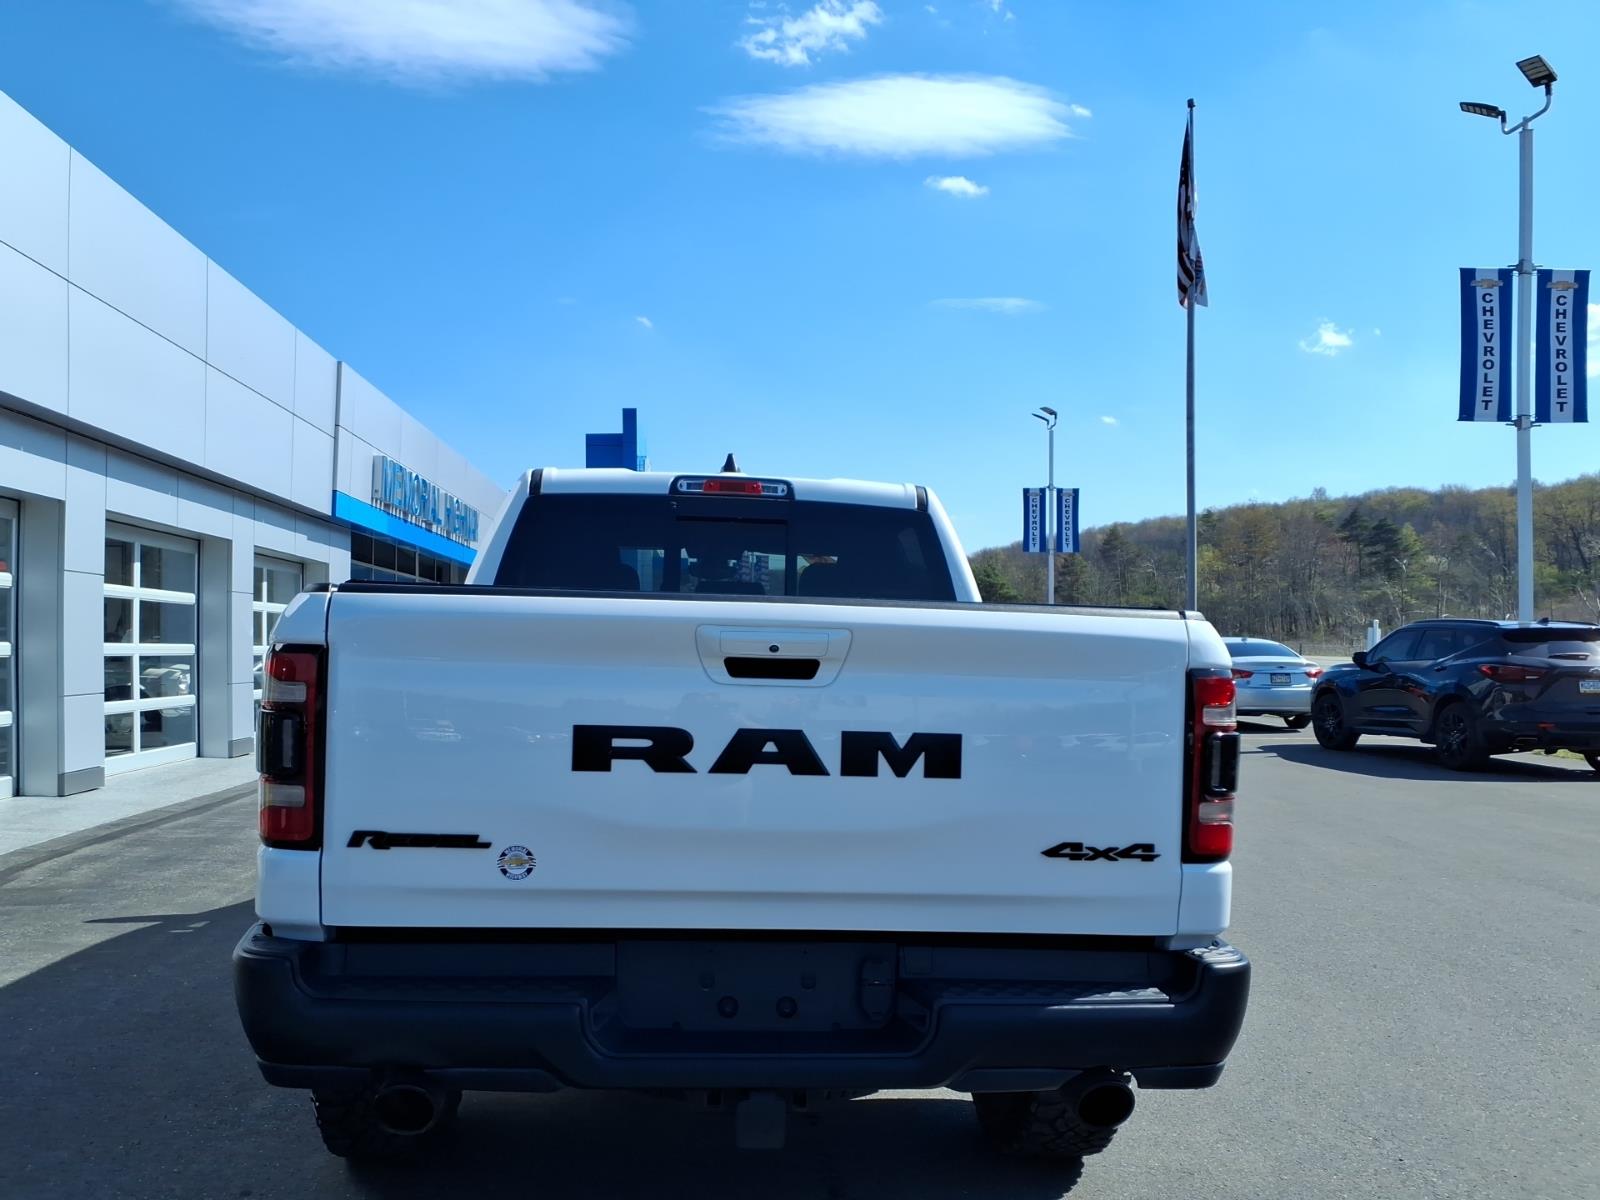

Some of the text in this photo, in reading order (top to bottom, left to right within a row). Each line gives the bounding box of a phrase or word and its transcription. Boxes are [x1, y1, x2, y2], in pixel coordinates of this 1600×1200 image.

[1482, 293, 1494, 410] CHEVROLET
[1556, 295, 1567, 412] CHEVROLET
[572, 725, 962, 779] RAM
[1040, 842, 1161, 862] 4x4
